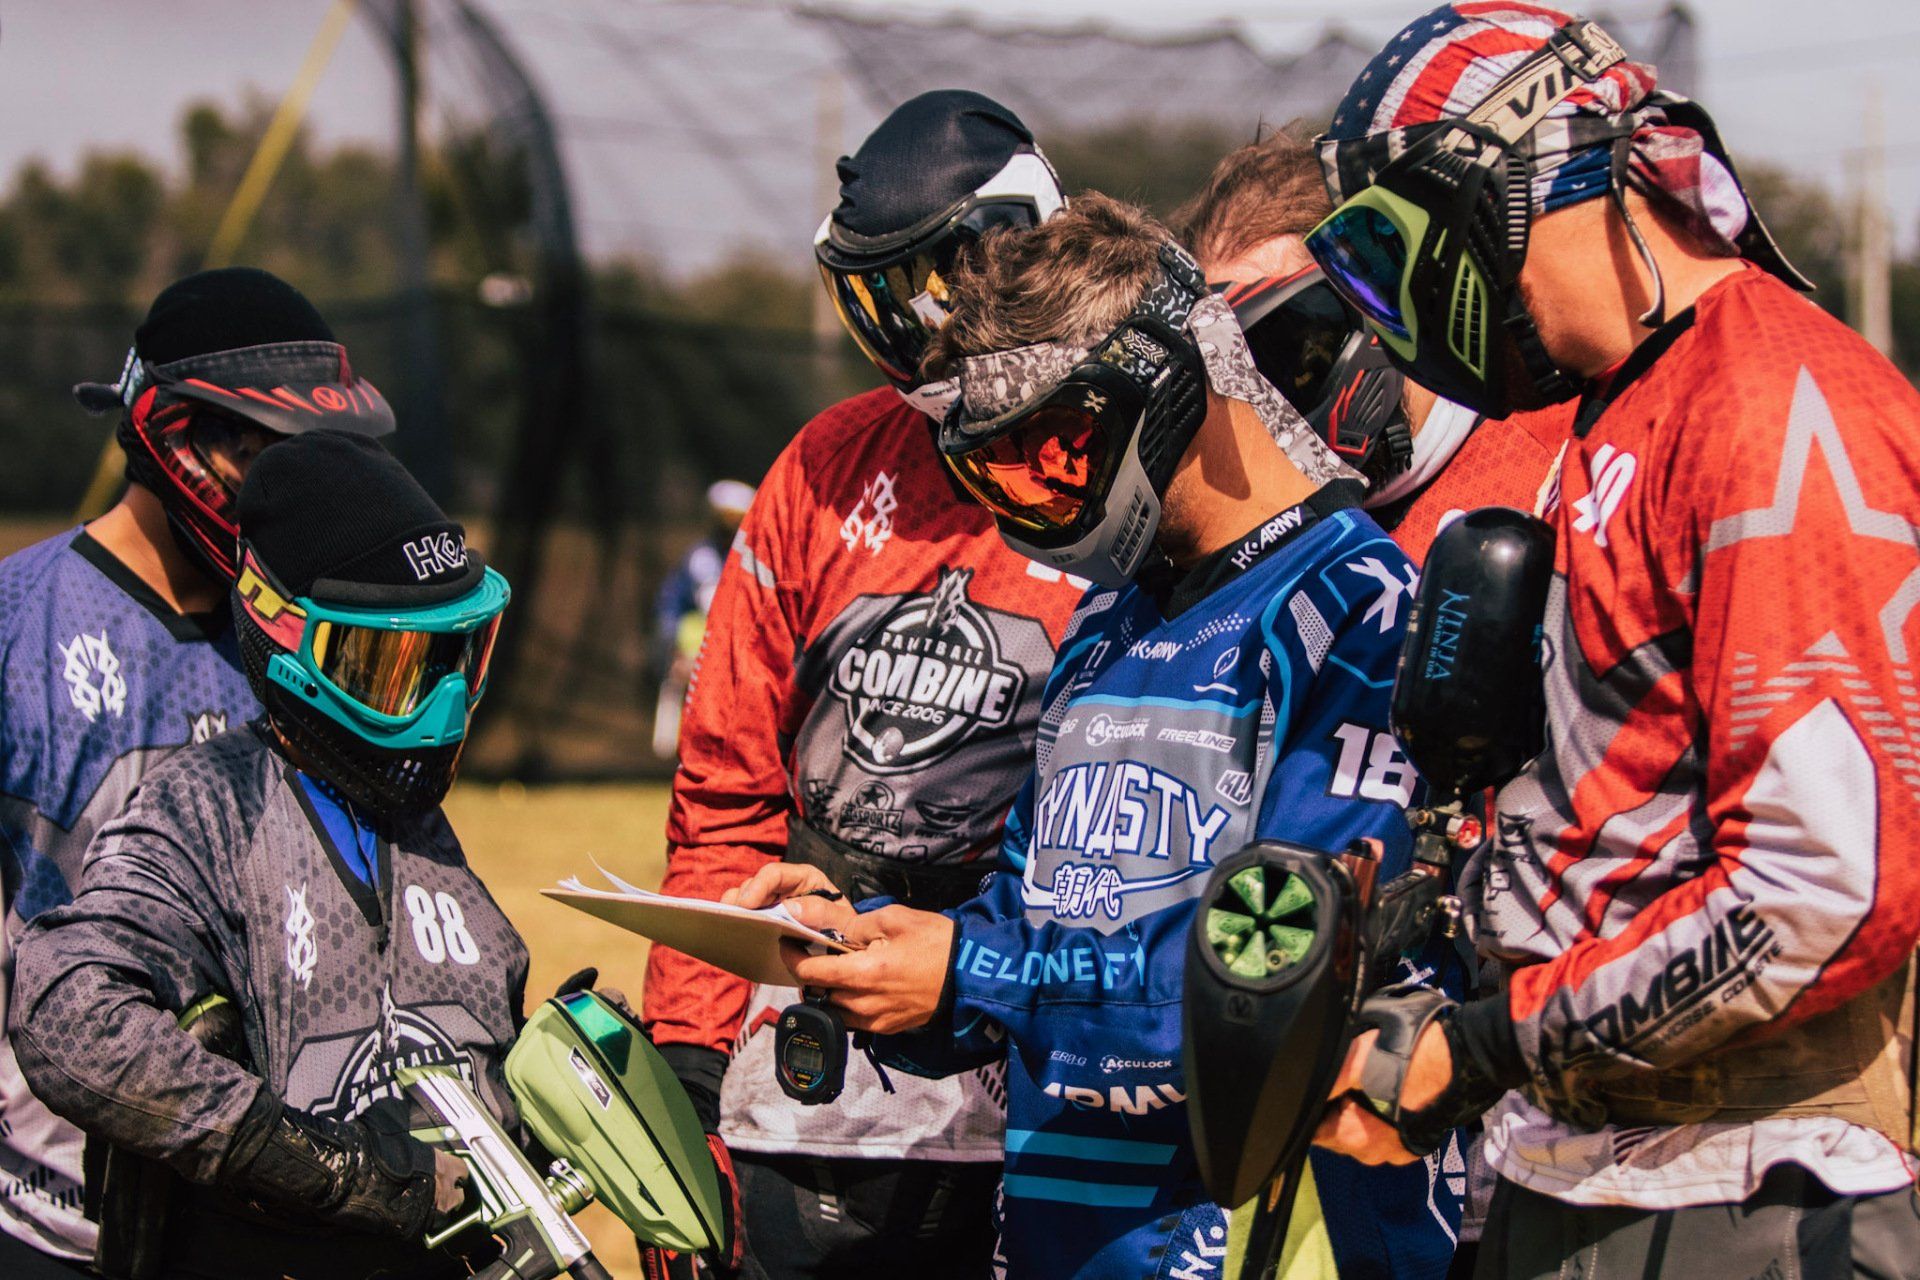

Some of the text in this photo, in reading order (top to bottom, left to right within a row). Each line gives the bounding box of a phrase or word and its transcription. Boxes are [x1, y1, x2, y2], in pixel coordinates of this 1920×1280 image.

[1432, 588, 1471, 679] NINJA
[902, 704, 946, 725] 2006
[1157, 727, 1235, 752] FREELINE
[1330, 722, 1420, 810] 18
[1054, 864, 1122, 917] 朝代
[404, 884, 481, 965] 88
[1106, 1058, 1172, 1070] ACCULOCK
